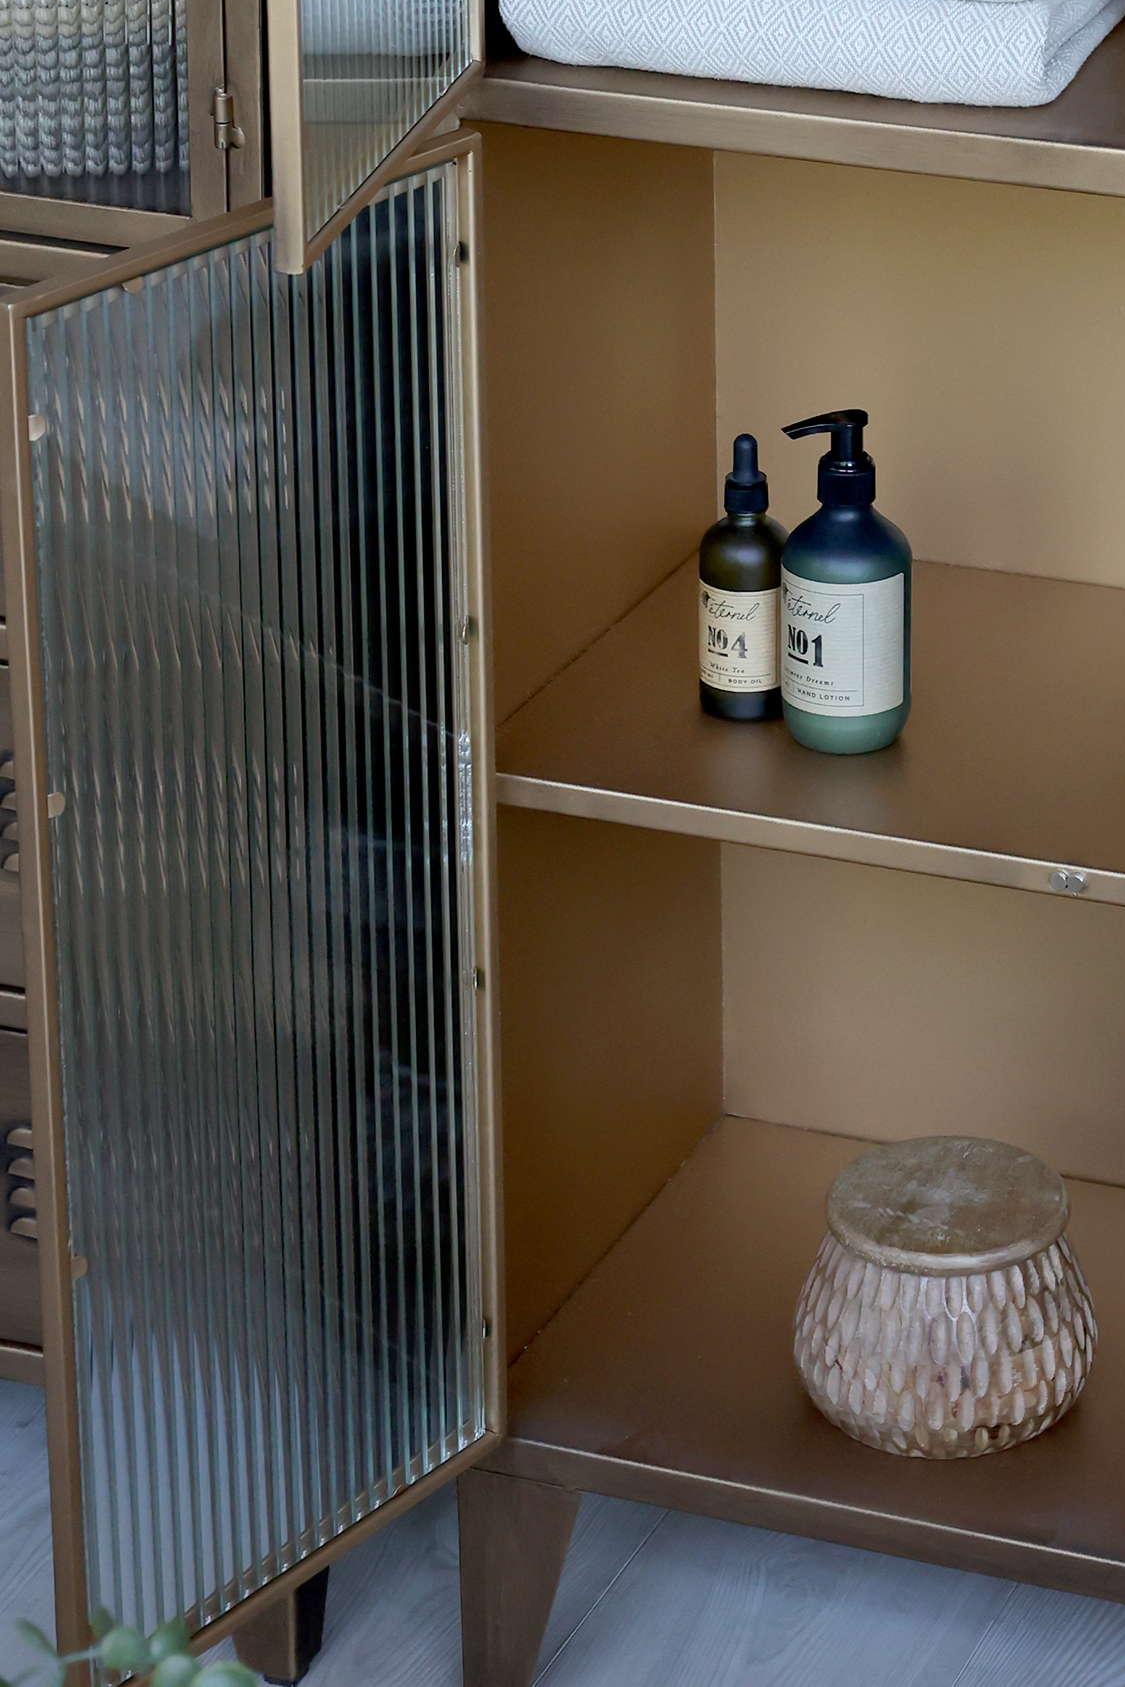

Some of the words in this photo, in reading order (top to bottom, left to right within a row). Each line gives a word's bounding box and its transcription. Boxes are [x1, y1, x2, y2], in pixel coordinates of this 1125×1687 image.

[710, 662, 728, 672] White
[806, 676, 835, 686] Dreams
[796, 687, 817, 698] HAND
